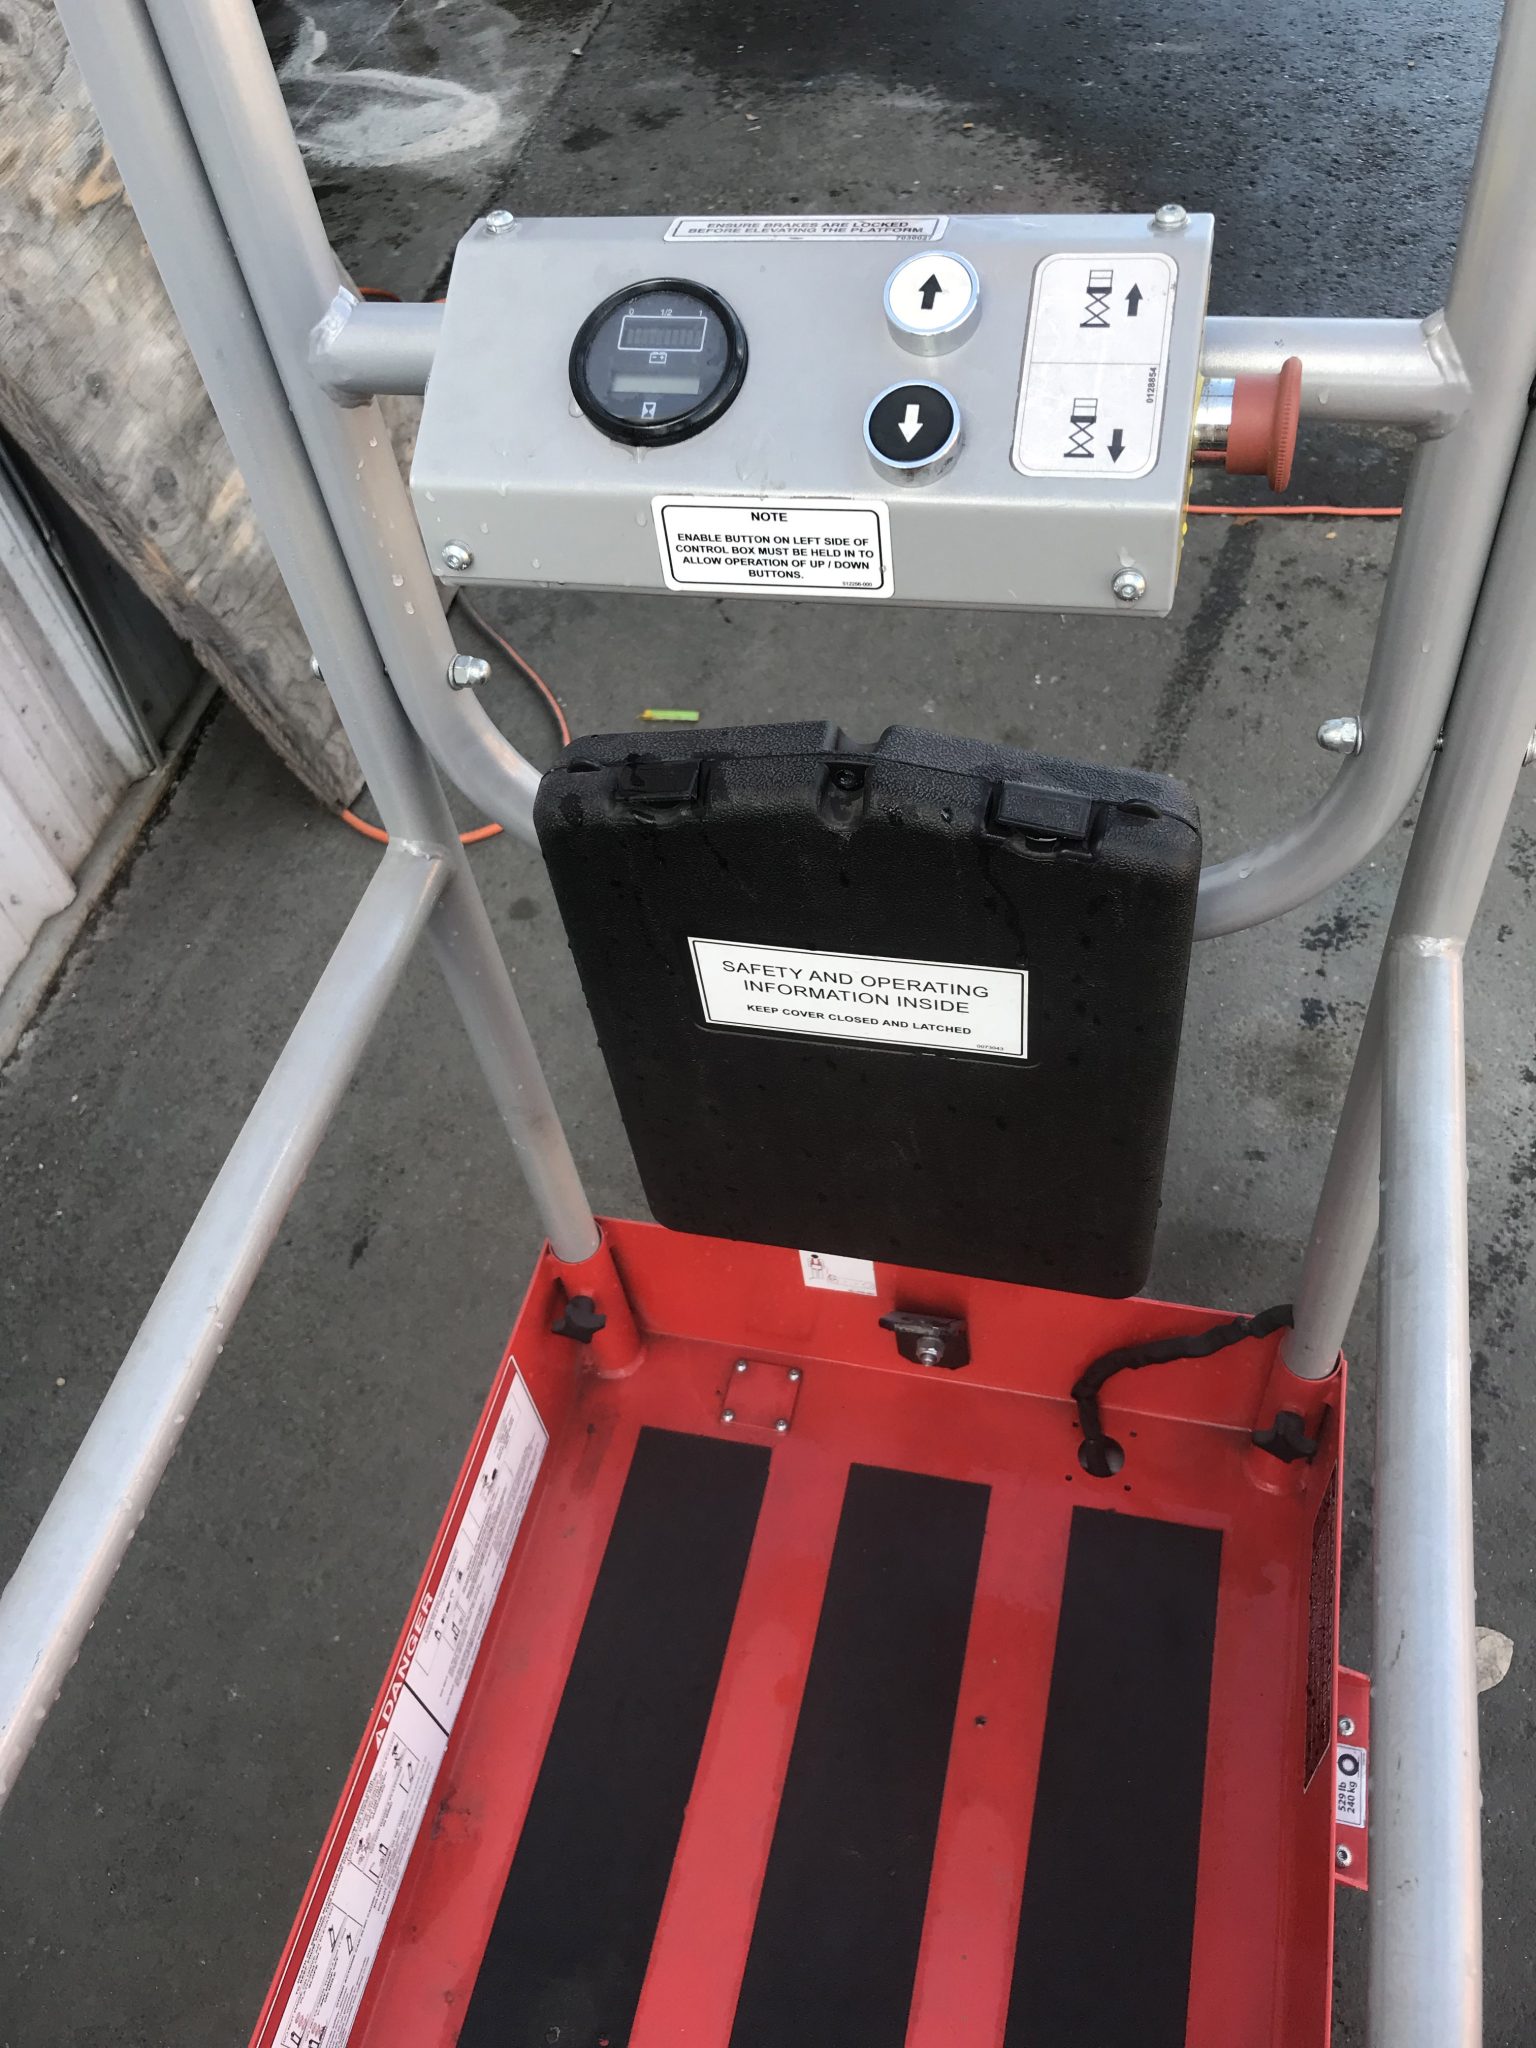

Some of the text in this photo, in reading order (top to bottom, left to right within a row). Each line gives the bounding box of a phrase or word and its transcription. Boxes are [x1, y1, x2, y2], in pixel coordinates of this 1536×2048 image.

[629, 308, 635, 316] 0
[660, 308, 673, 317] 1/2
[751, 512, 788, 522] NOTE
[677, 533, 869, 546] ENABLE BUTTON ON LEFT SIDE OF
[676, 544, 874, 559] CONTROL BOX MUST BE HELD IN TO
[682, 556, 870, 570] ALLOW OPERATION OF UP / DOWN
[748, 569, 805, 579] BUTTONS.
[722, 960, 989, 998] SAFETY AND OPERATING
[744, 980, 970, 1014] INFORMATION INSIDE
[746, 1004, 972, 1035] KEEP COVER CLOSED AND LATCHED
[382, 1591, 434, 1723] DANGER
[1338, 1781, 1346, 1812] 529 lb
[1347, 1781, 1357, 1814] 240 kg
